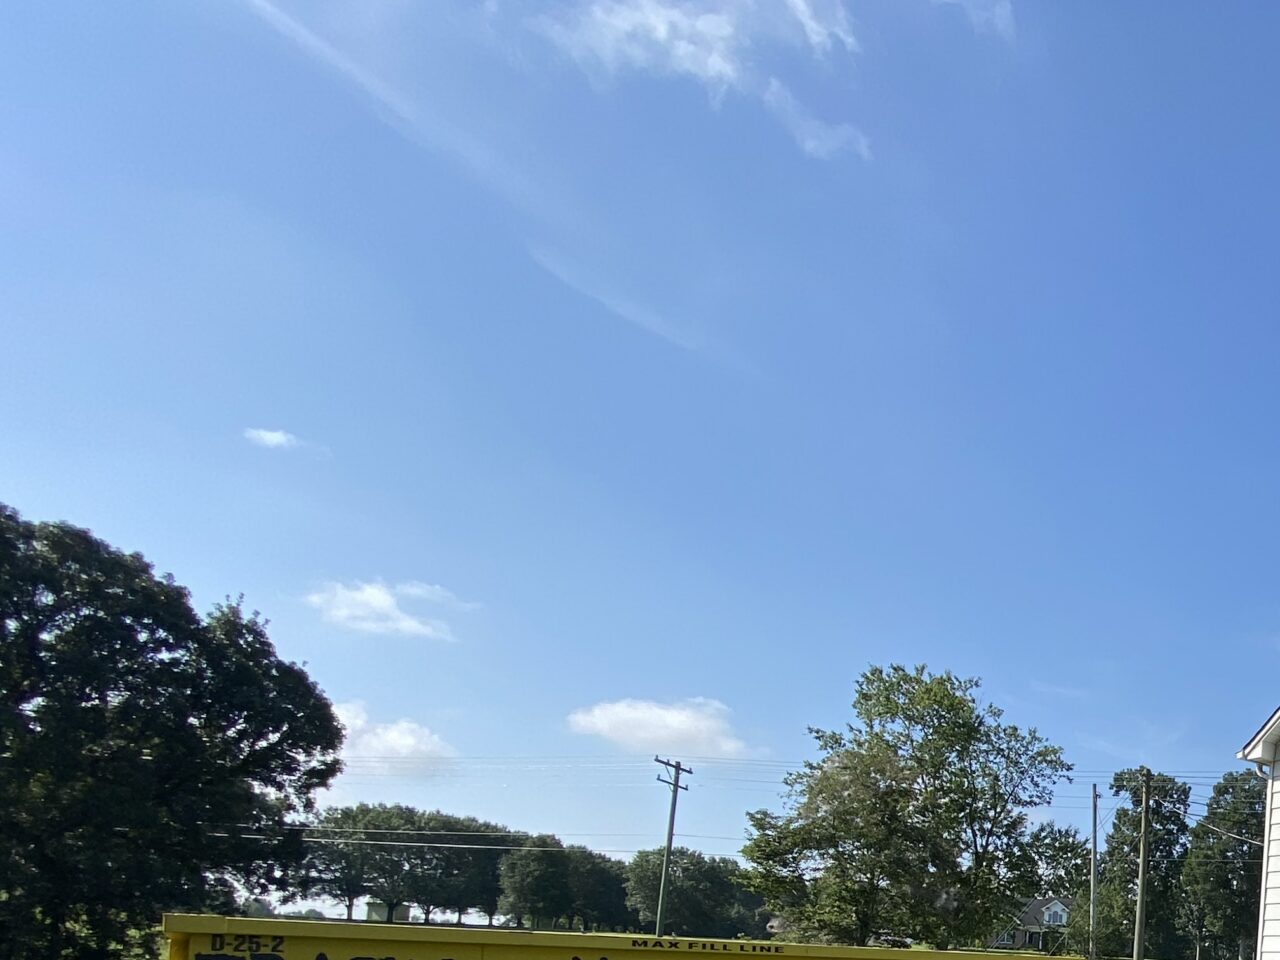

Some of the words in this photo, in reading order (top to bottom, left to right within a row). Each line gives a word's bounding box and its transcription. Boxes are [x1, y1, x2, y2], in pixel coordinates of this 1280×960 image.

[632, 939, 680, 950] MAX
[688, 942, 733, 952] FILL
[739, 944, 785, 954] LINE
